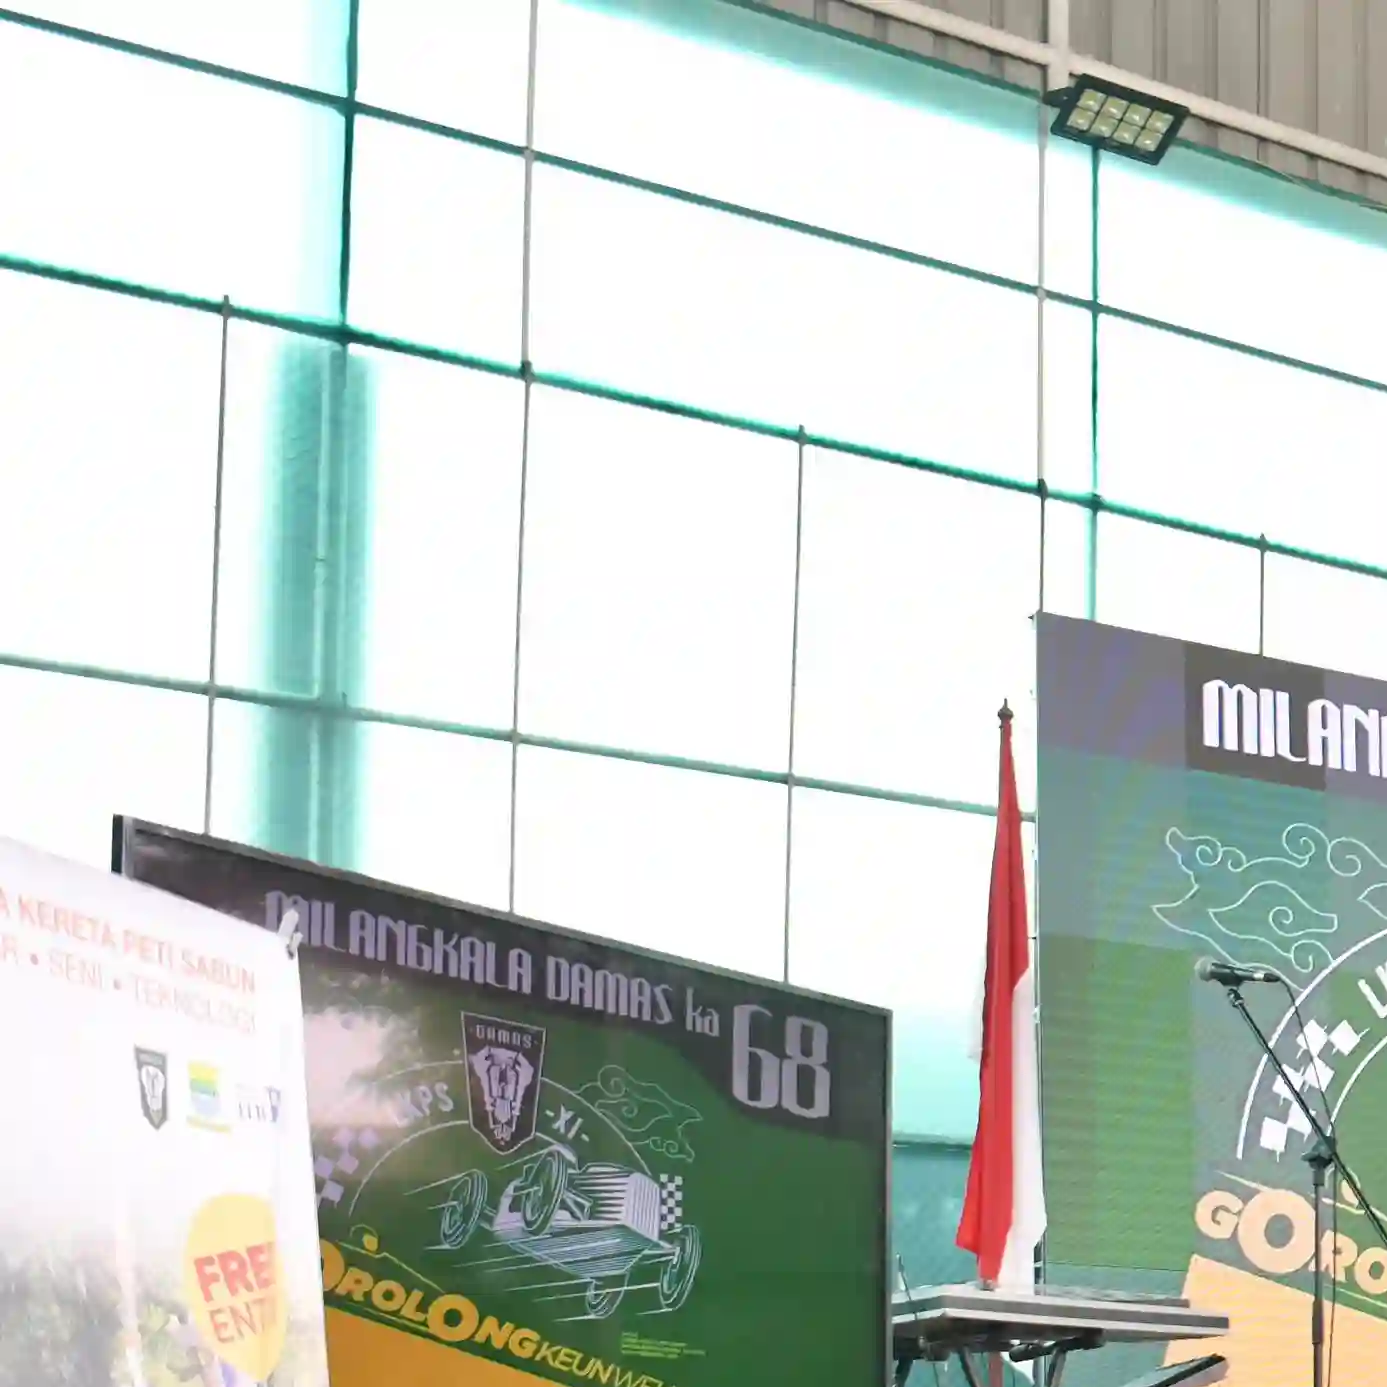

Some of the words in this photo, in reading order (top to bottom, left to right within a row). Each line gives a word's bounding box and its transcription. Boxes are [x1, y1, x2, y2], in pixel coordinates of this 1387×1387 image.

[18, 895, 117, 950] KERETA
[123, 929, 174, 969] PETI
[546, 955, 673, 1026] DAMAS
[685, 986, 720, 1037] ka
[732, 1003, 830, 1119] 68
[193, 1241, 276, 1303] FRE
